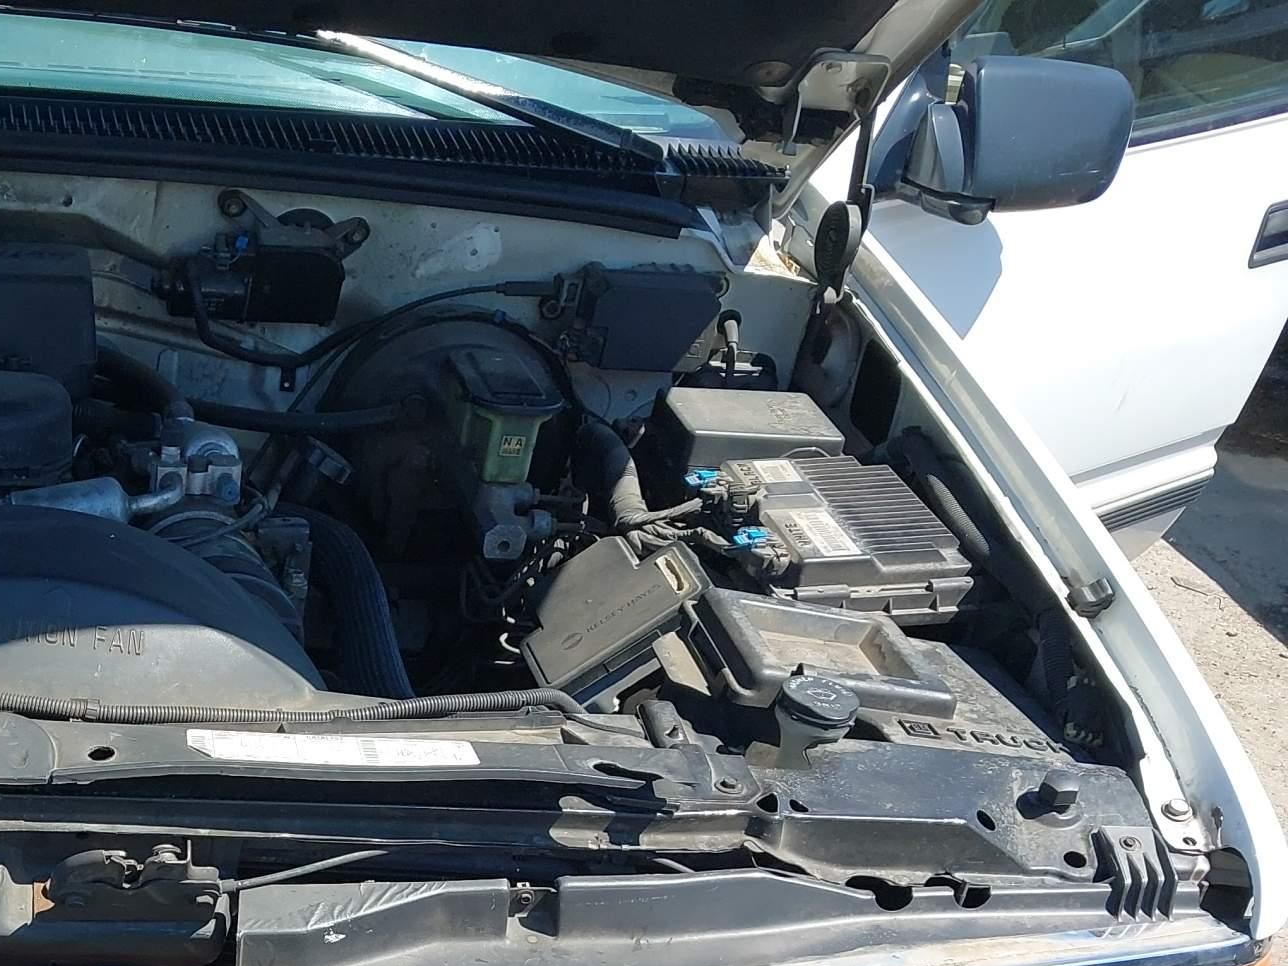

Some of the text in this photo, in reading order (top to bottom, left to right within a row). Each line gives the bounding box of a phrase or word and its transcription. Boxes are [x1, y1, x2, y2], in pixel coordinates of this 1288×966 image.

[784, 523, 812, 547] WHITE
[92, 625, 144, 656] FAN
[946, 726, 1073, 756] TRUCK
